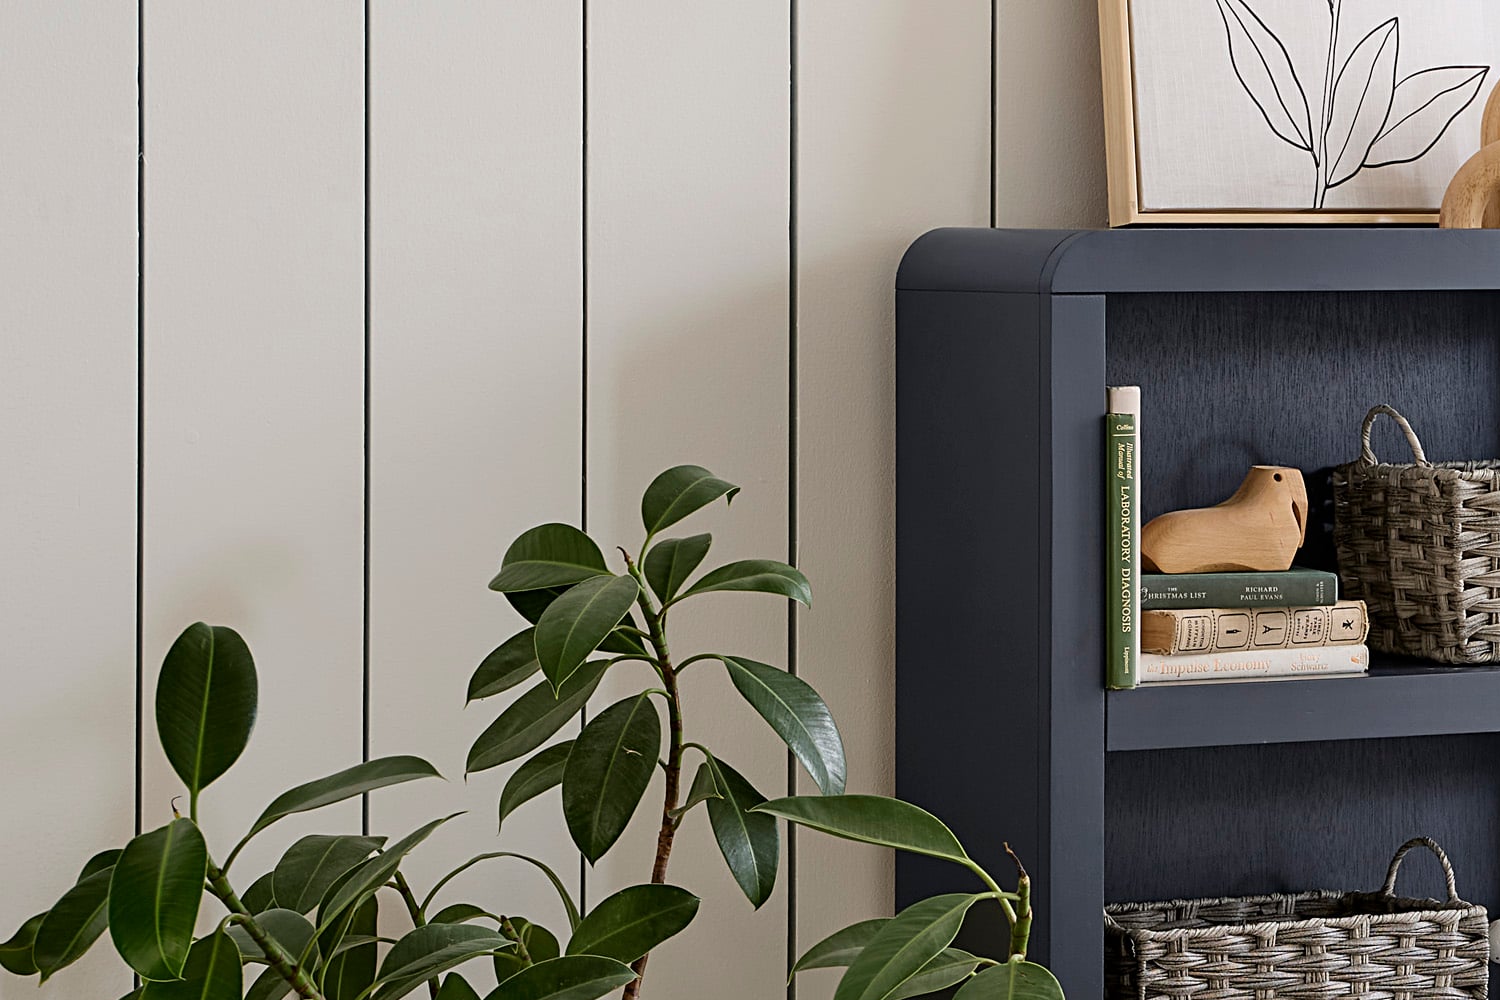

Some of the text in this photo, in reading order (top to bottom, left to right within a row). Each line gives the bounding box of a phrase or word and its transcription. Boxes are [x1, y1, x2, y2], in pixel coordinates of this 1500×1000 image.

[1117, 470, 1126, 480] of
[1121, 486, 1131, 633] LABORATORY DIAGNOSIS
[1160, 660, 1209, 677] Impulse
[1213, 658, 1271, 673] Economy
